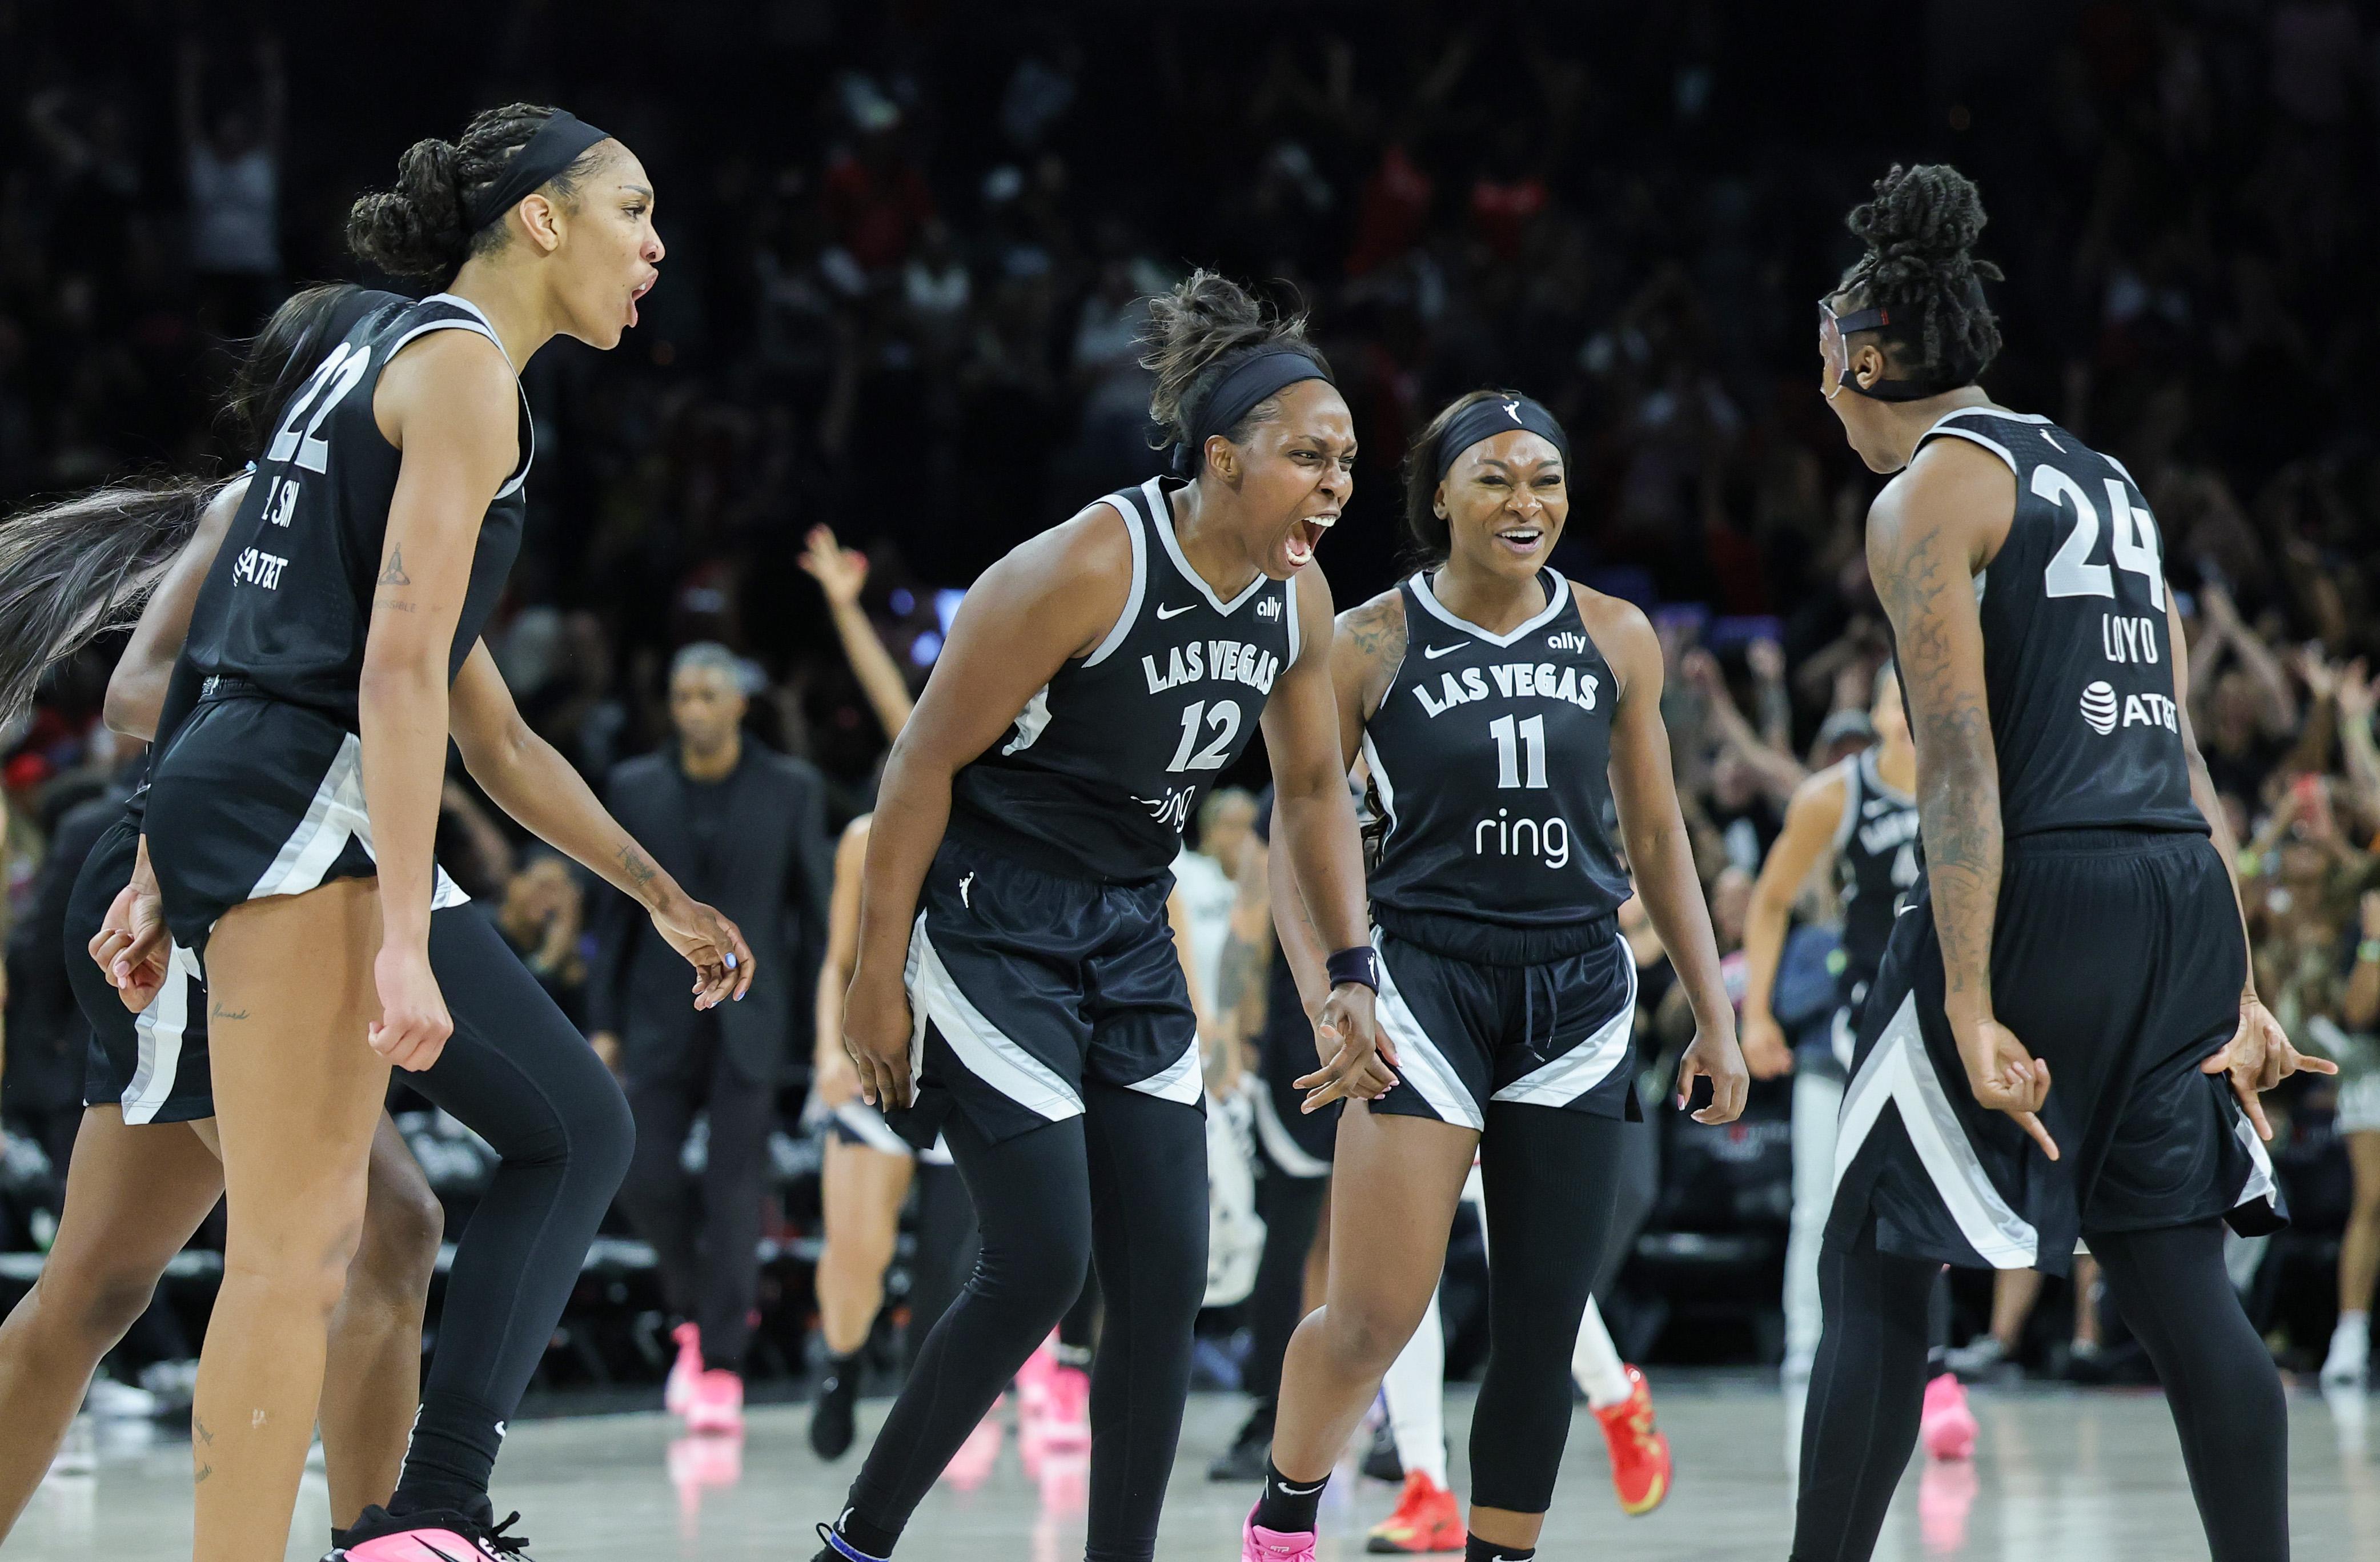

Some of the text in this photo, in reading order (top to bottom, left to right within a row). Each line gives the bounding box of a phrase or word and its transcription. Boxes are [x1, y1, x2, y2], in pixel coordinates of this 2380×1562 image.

[266, 341, 372, 475] 22
[2030, 463, 2167, 613] 24
[239, 548, 289, 591] AT&T
[1256, 596, 1283, 623] ally
[1547, 631, 1587, 654] ally
[2102, 613, 2159, 665] LOYD
[1141, 640, 1279, 696] LAS VEGAS
[1411, 662, 1600, 719] LAS VEGAS
[1165, 699, 1242, 773] 12
[2122, 693, 2178, 735] AT&T
[1488, 713, 1549, 789] 11
[1130, 784, 1197, 834] ring
[1475, 808, 1570, 869] ring
